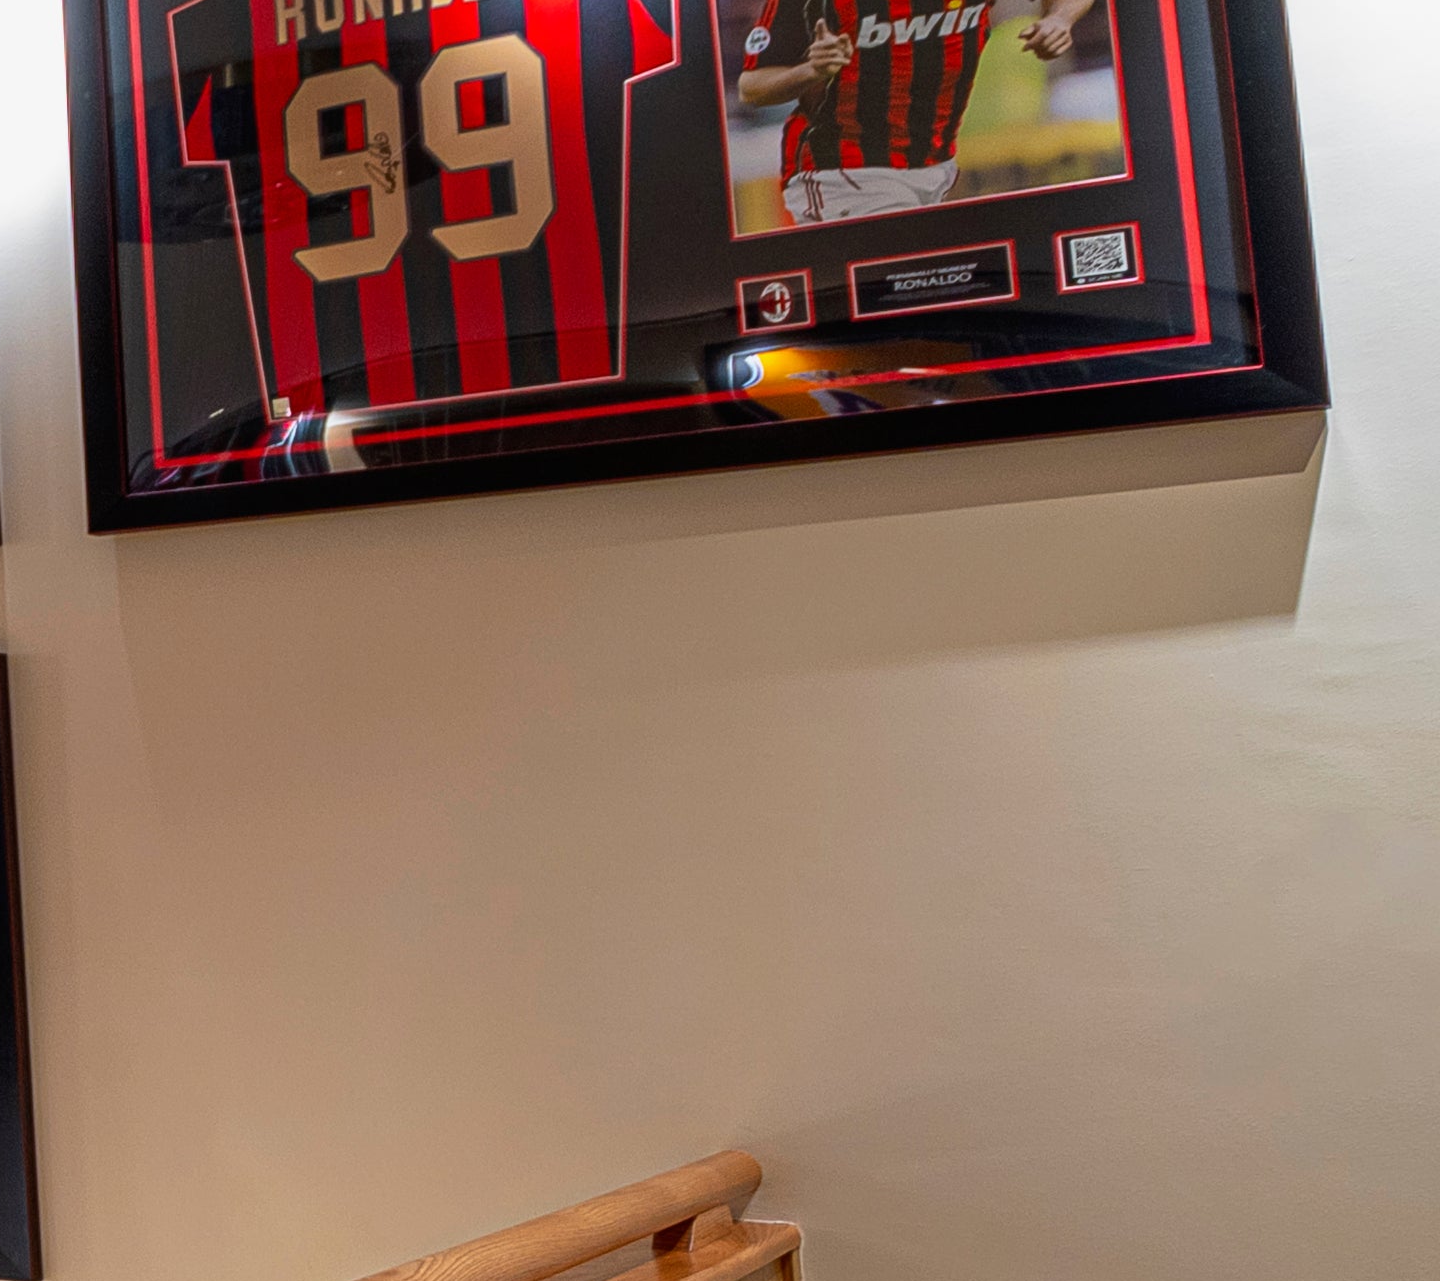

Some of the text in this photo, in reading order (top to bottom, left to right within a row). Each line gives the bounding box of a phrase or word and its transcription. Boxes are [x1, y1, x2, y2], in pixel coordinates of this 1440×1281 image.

[856, 3, 986, 49] bwin
[285, 32, 557, 283] 99
[894, 272, 972, 292] RONALDO
